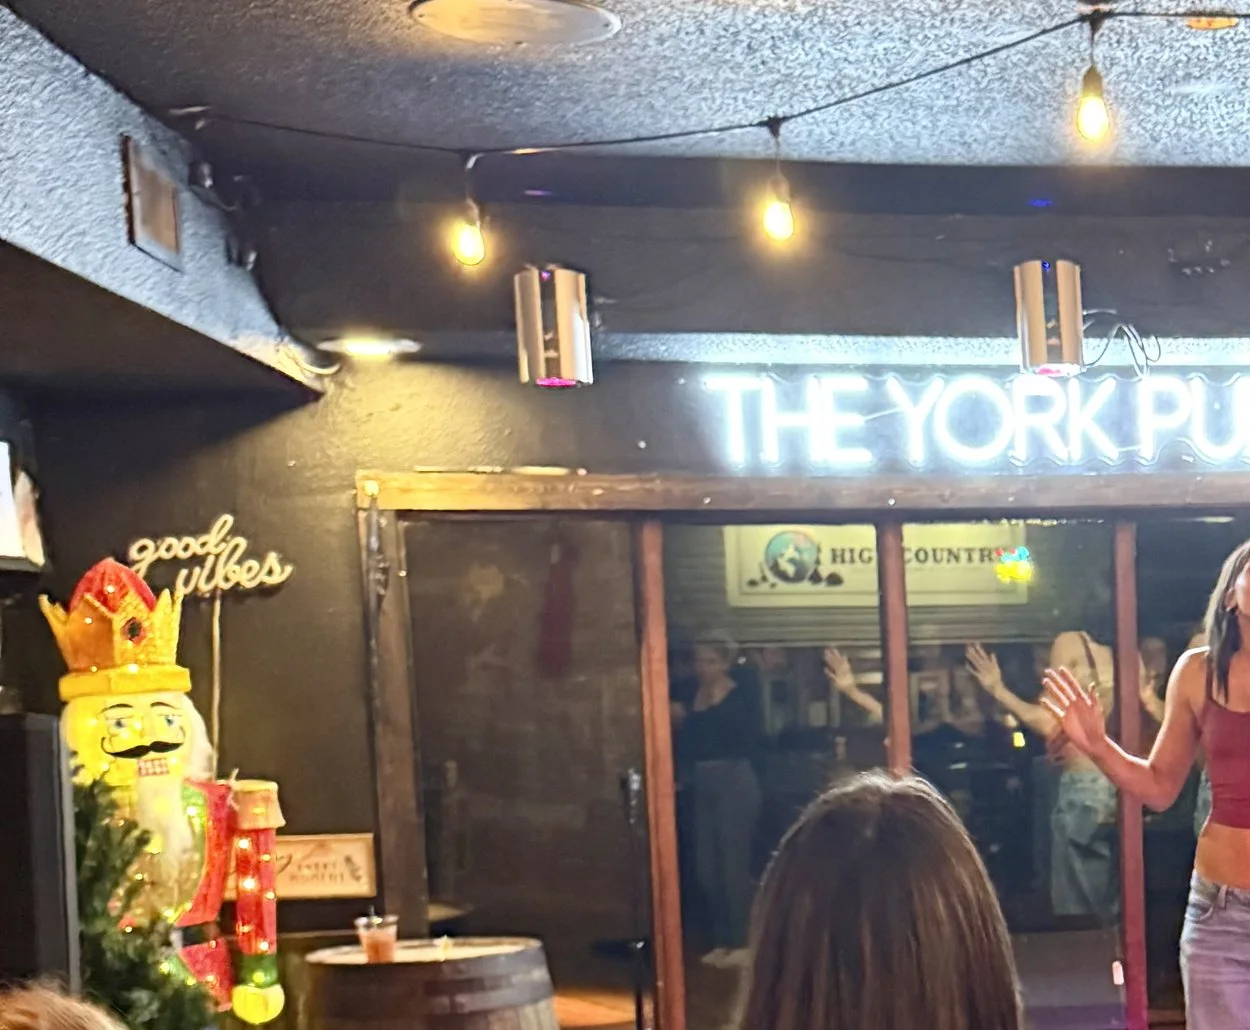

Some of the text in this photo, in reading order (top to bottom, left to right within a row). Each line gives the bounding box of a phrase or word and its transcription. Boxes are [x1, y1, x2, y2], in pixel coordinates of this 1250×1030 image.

[701, 373, 873, 466] THE
[885, 374, 1120, 466] YORK
[128, 513, 235, 579] good
[175, 536, 294, 597] vibes
[830, 547, 1002, 565] HIG COUNTR
